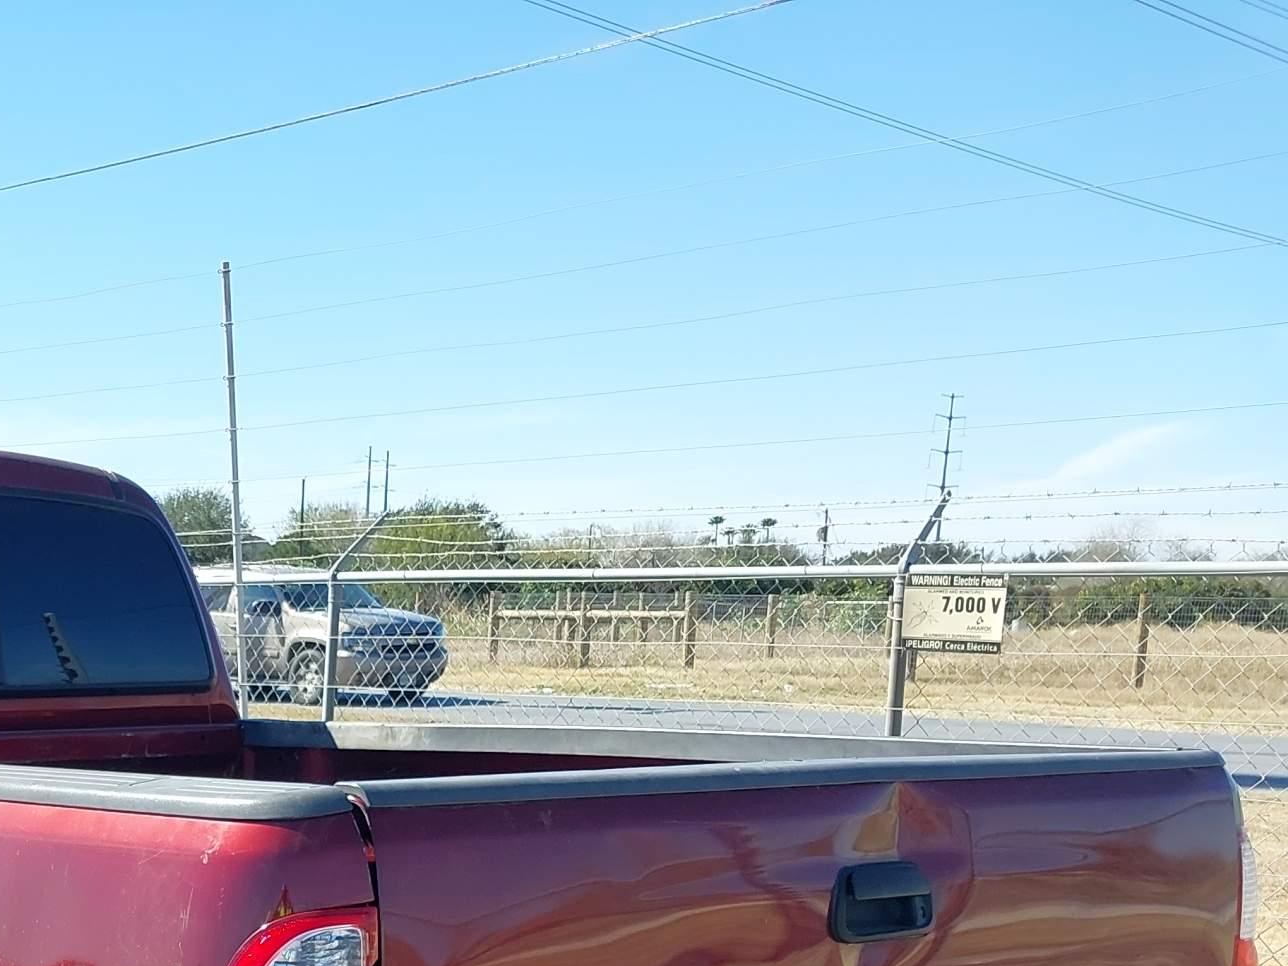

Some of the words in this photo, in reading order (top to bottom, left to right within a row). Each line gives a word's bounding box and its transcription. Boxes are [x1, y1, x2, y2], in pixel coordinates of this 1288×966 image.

[912, 575, 952, 586] WARNING!
[953, 575, 980, 586] Electric
[981, 575, 1003, 587] Fence
[942, 596, 986, 614] 7,000
[992, 597, 1002, 614] V
[945, 642, 965, 651] Cerca
